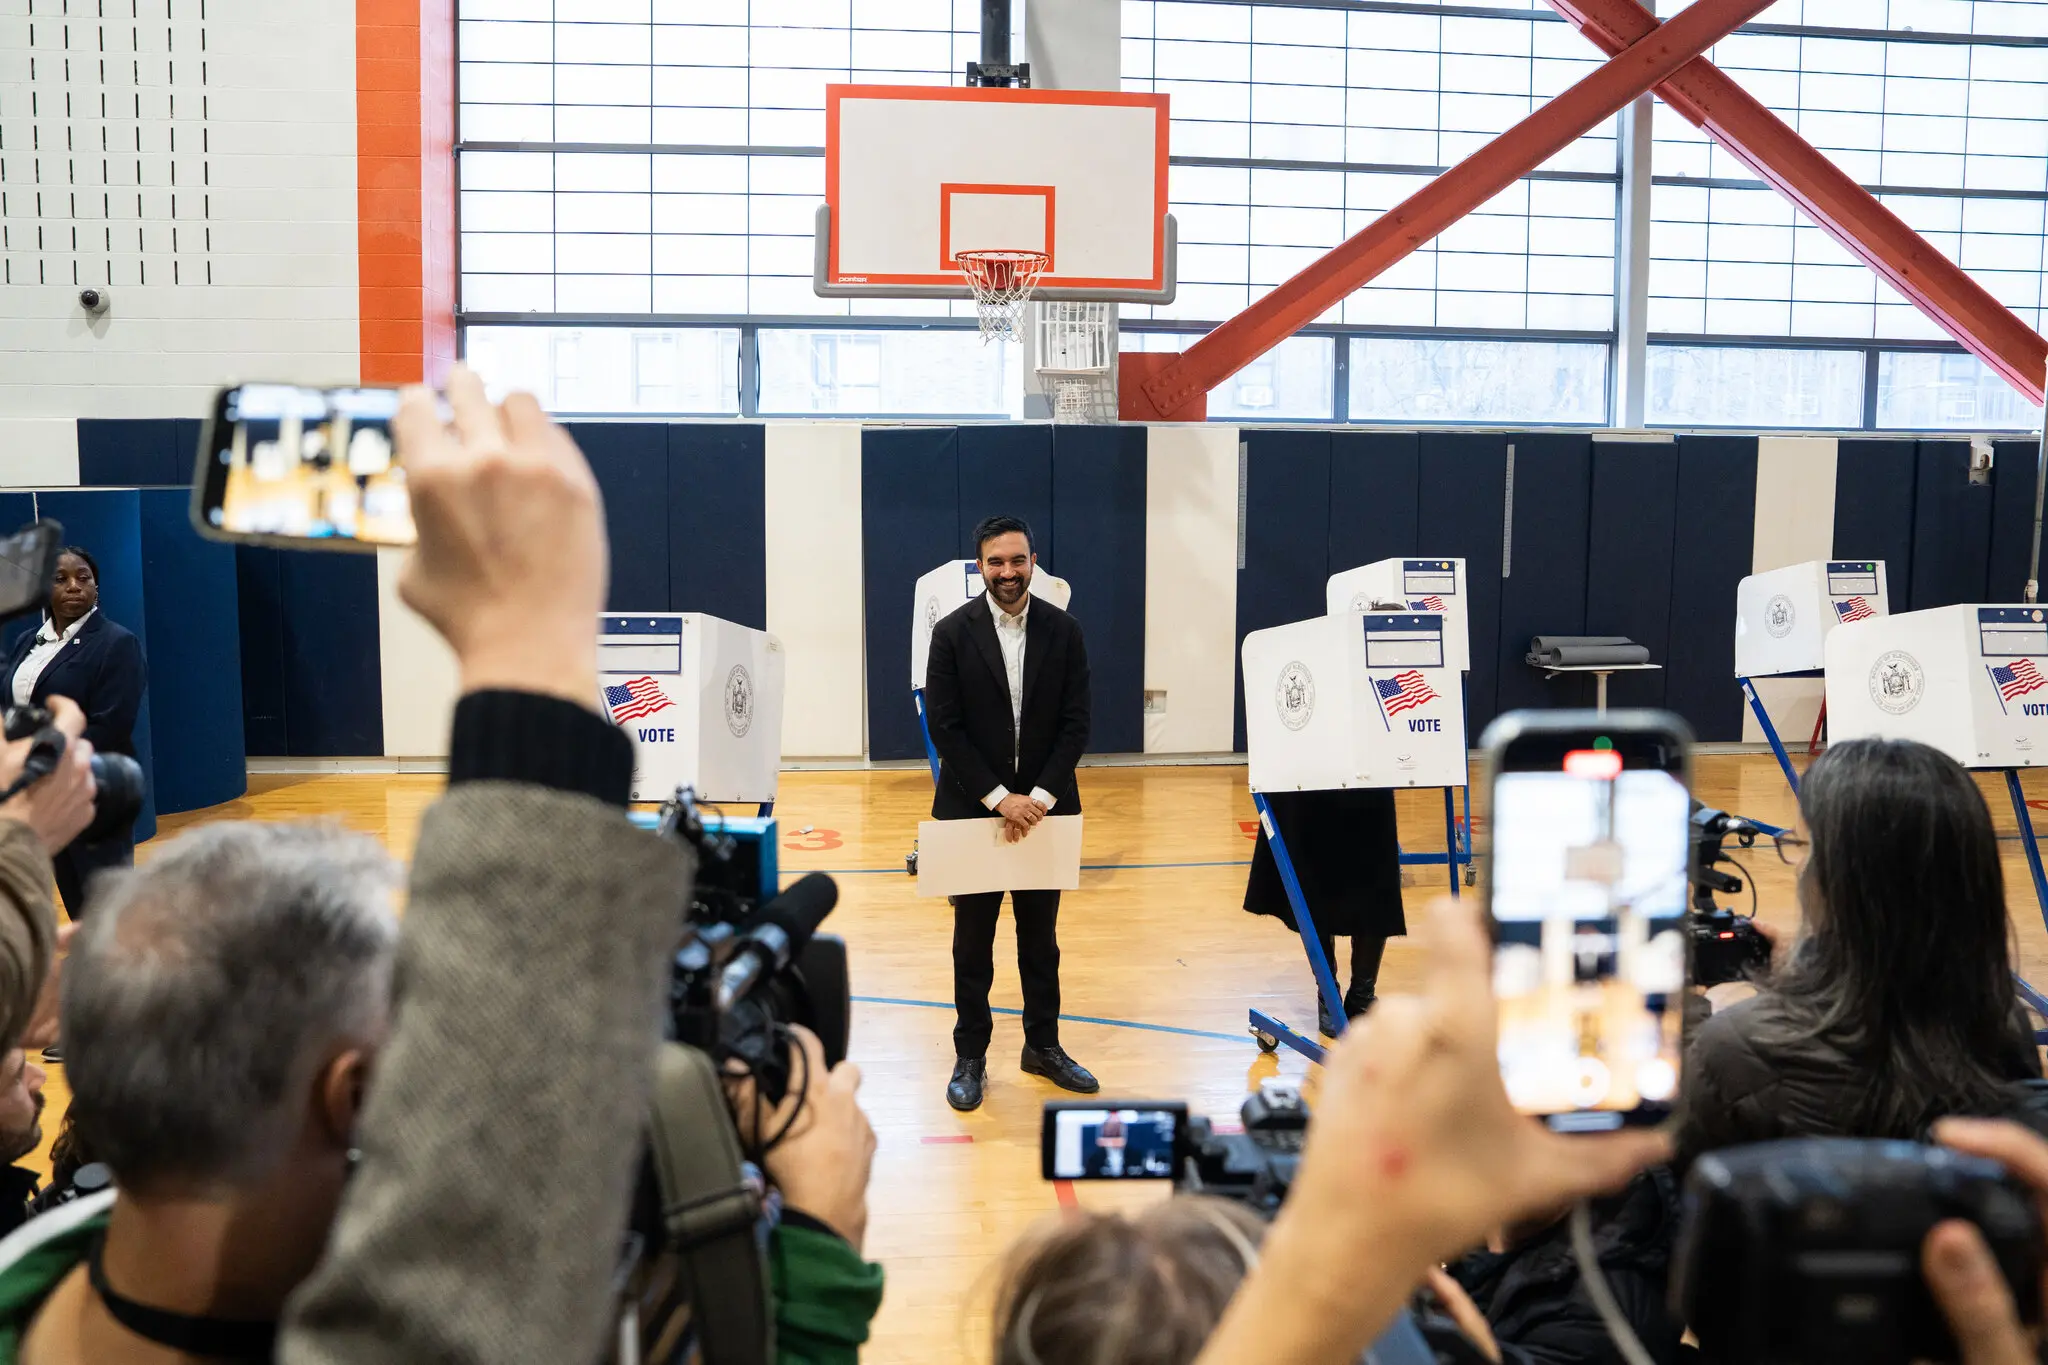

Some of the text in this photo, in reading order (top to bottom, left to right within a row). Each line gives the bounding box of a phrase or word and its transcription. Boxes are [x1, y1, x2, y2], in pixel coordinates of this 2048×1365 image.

[2022, 703, 2048, 716] VOT
[1408, 718, 1441, 732] VOTE
[638, 728, 675, 743] VOTE
[783, 829, 844, 851] 3
